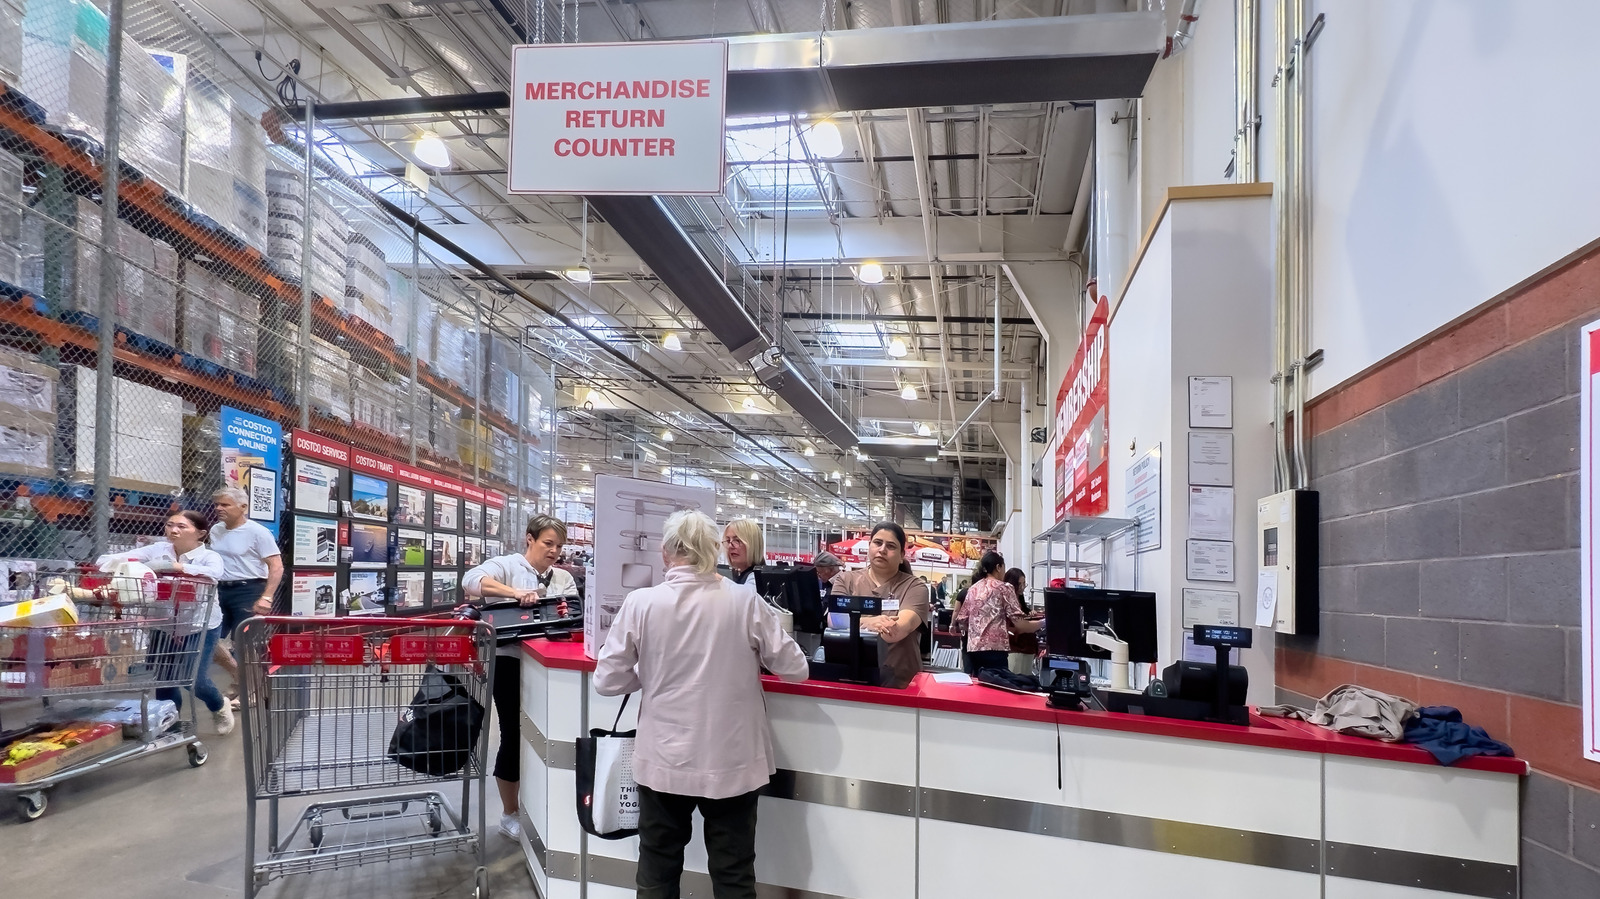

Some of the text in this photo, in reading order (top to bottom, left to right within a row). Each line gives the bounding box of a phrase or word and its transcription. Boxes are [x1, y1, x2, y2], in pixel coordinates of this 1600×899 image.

[525, 79, 710, 100] MERCHANDISE
[565, 109, 665, 128] RETURN
[554, 138, 675, 157] COUNTER
[1056, 323, 1104, 452] MEMBERSHIP
[228, 425, 276, 445] CONNECTION
[243, 420, 272, 434] COSTCO
[238, 438, 268, 452] ONLINE!
[297, 438, 348, 461] COSTCO SERVICES
[356, 454, 394, 474] COSTCO TRAVEL
